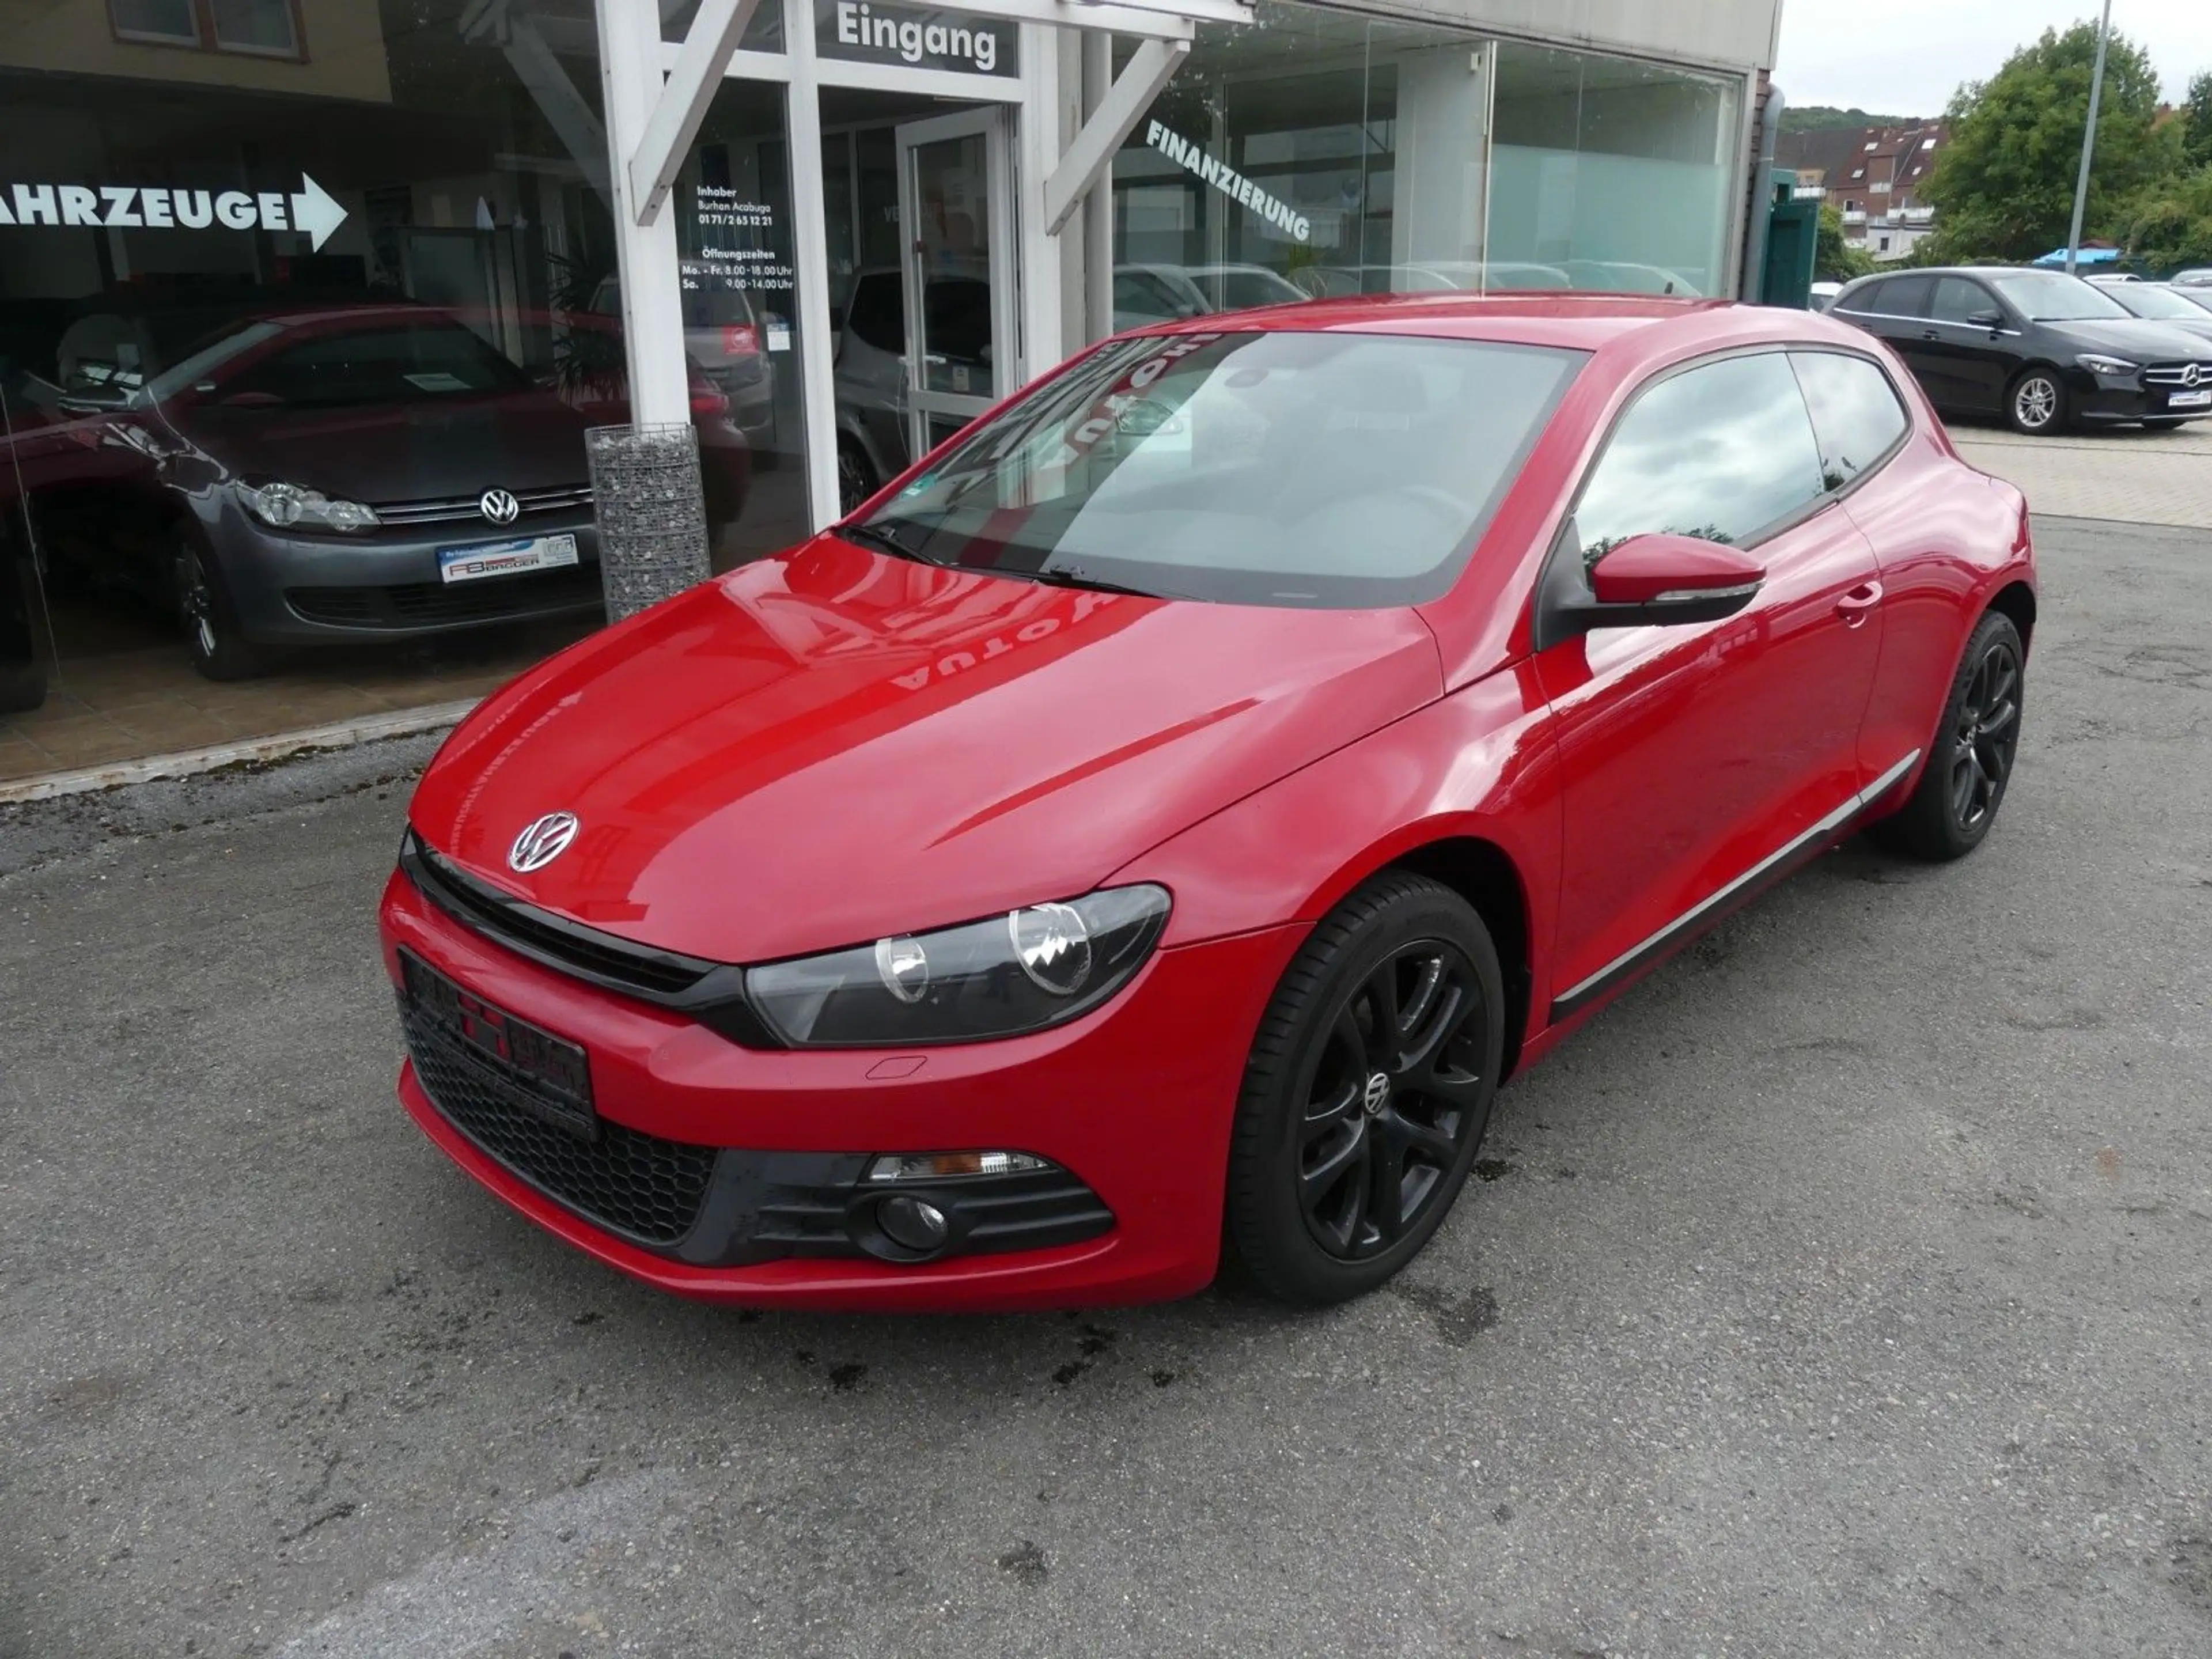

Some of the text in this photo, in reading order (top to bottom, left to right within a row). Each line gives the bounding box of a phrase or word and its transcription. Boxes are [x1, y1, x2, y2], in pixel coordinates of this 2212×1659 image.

[837, 2, 996, 71] Eingang
[1146, 119, 1310, 242] FINANZIERUNG
[697, 185, 737, 197] Inhaber
[698, 200, 730, 211] Burhan
[702, 245, 775, 261] Öffnungszeiten
[682, 265, 700, 275] Mo.
[777, 266, 793, 276] Uhr
[682, 279, 699, 289] Sa.
[778, 279, 793, 289] Uhr
